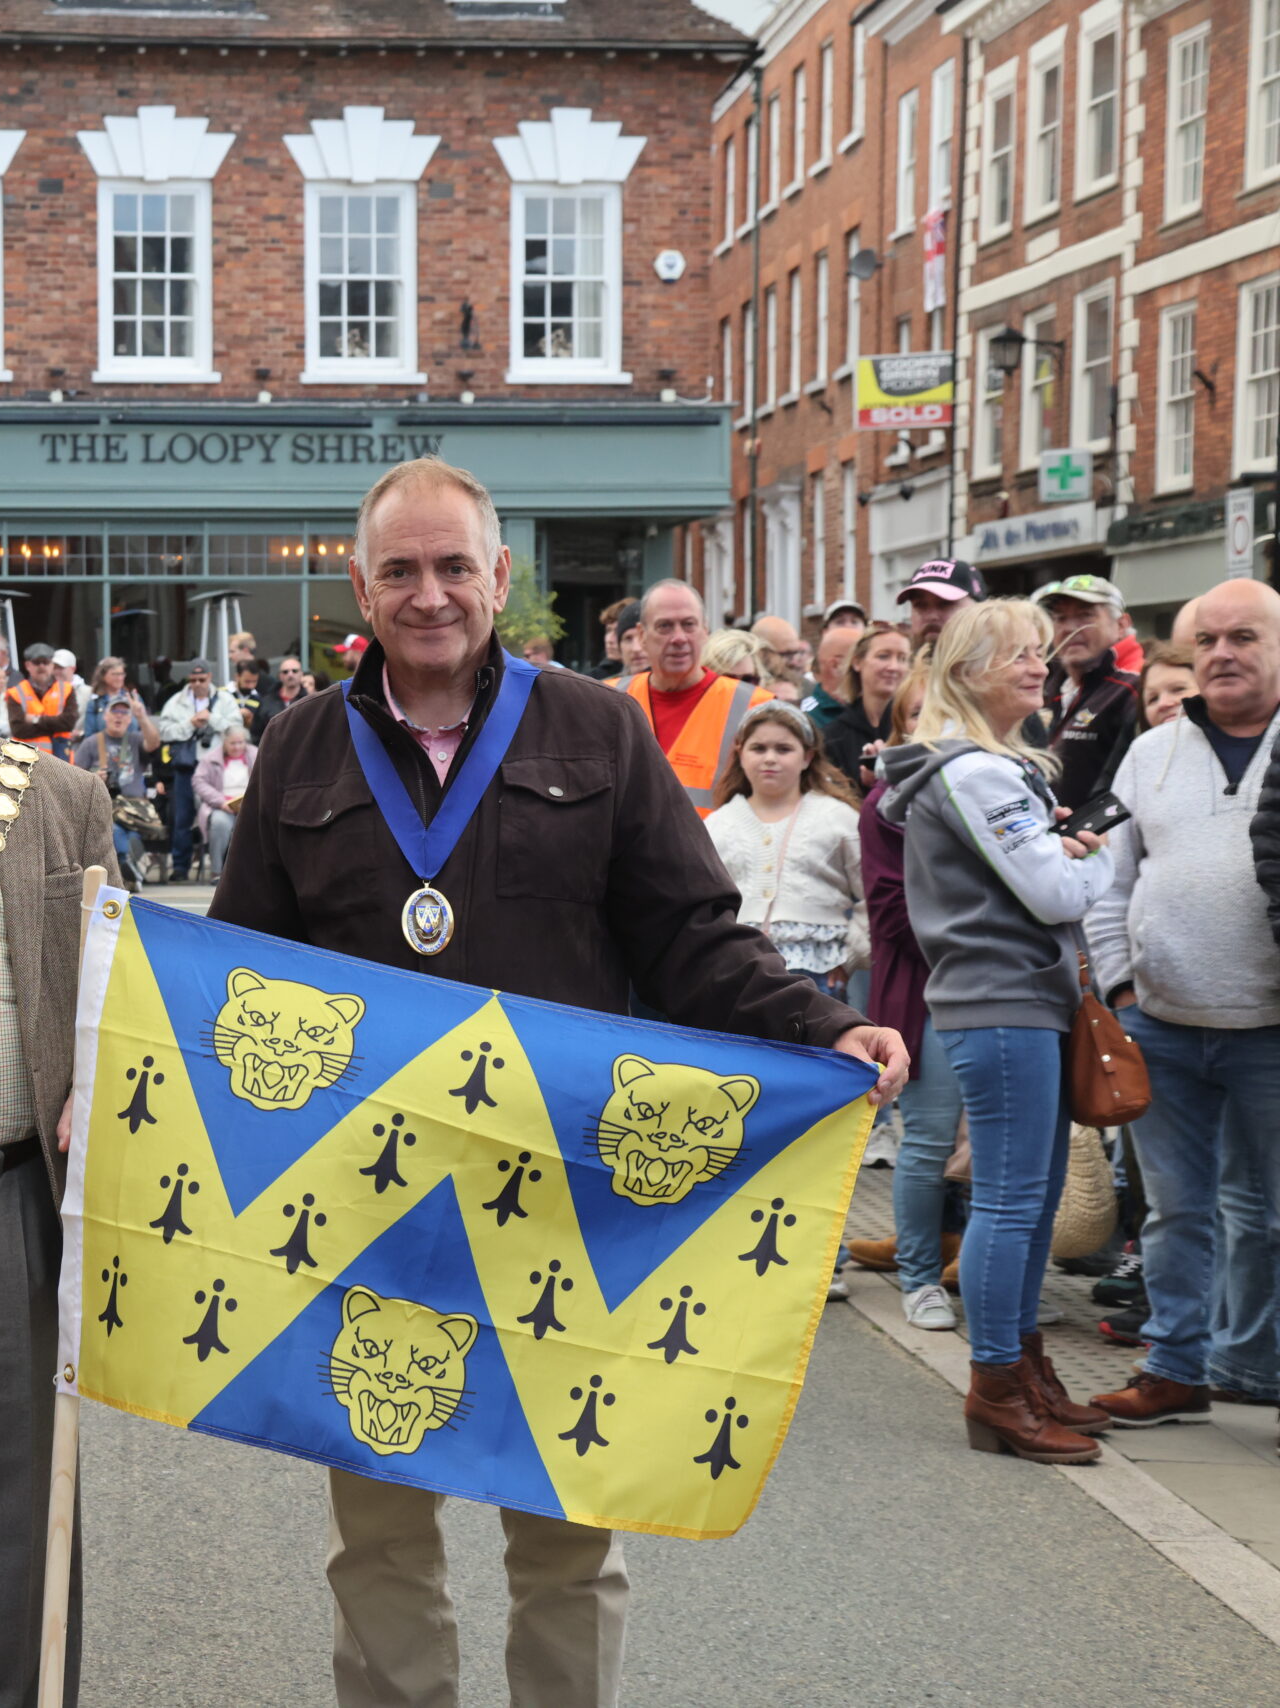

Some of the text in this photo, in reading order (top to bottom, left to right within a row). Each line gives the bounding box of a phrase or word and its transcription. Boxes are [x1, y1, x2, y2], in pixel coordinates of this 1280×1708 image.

[870, 405, 942, 424] SOLD
[40, 433, 445, 464] THE LOOPY SHREW
